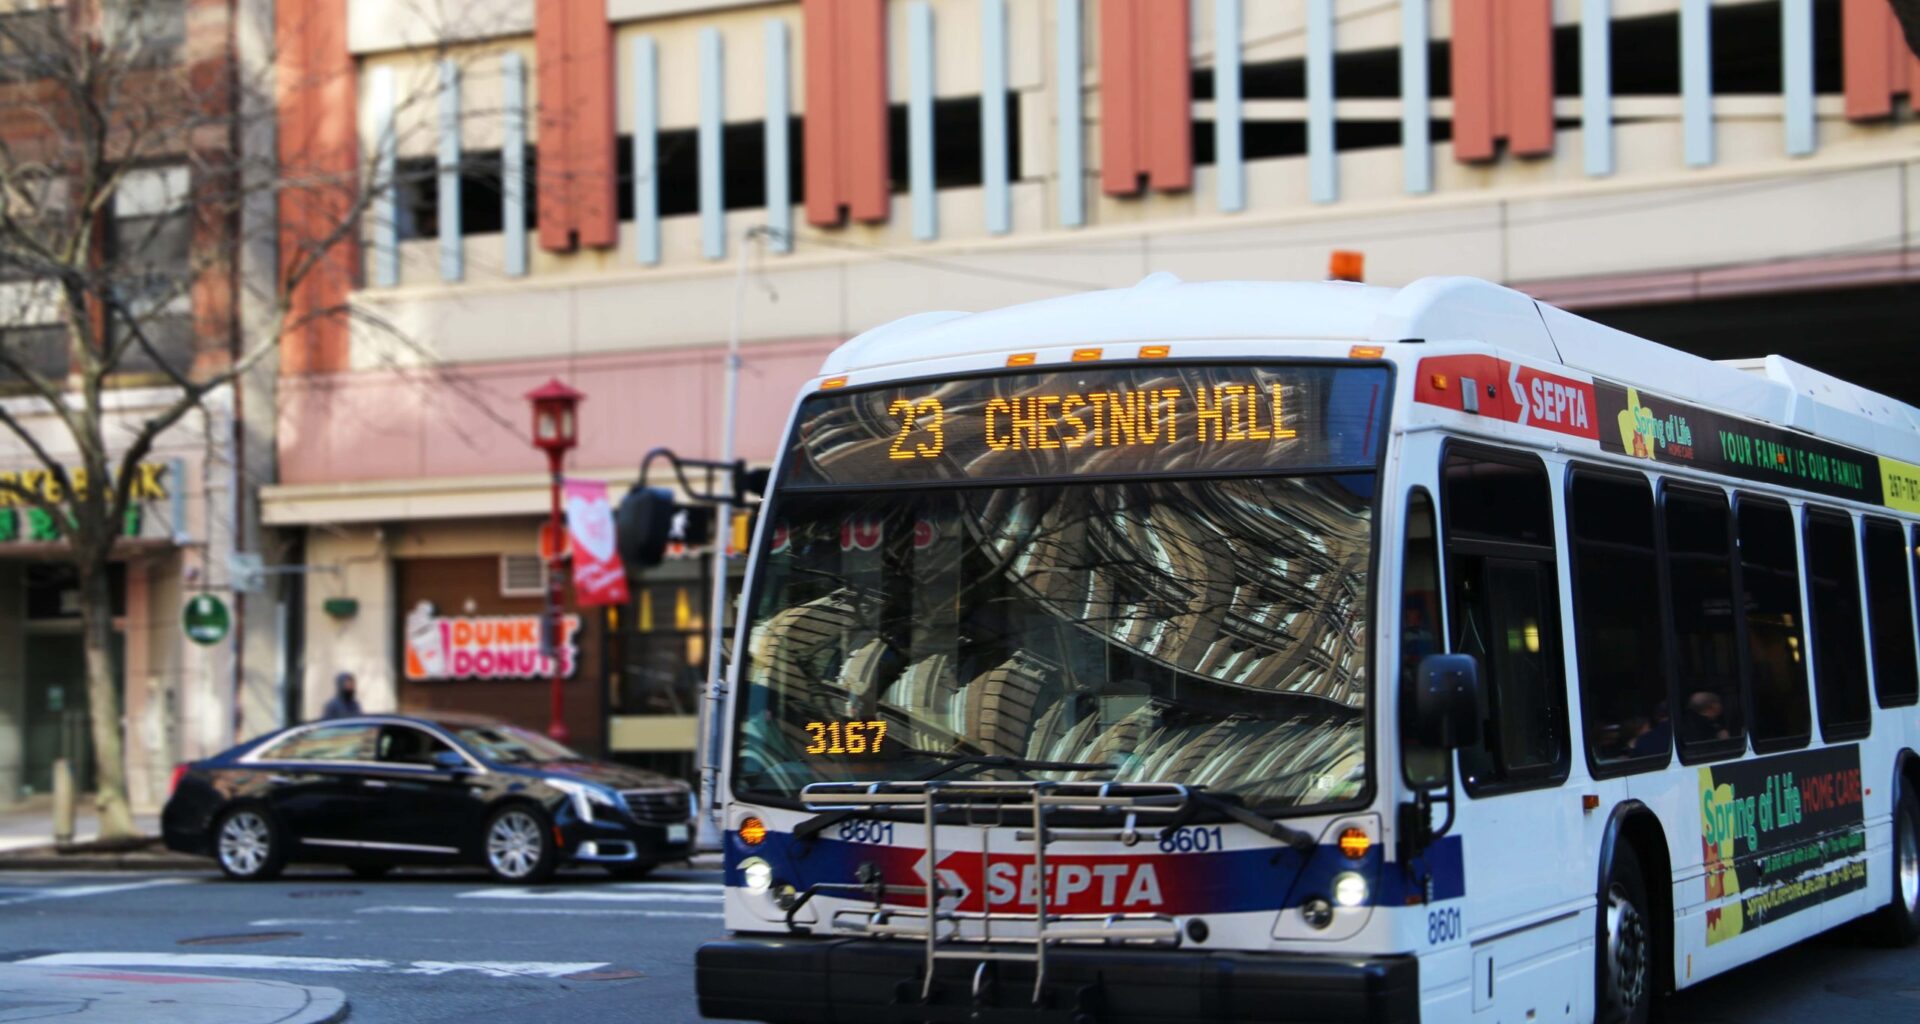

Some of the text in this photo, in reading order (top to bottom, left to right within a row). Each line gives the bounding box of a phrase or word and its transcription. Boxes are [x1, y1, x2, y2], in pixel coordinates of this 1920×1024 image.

[888, 383, 1297, 460] 23 CHESTNUT HILL
[1531, 377, 1589, 429] SEPTA
[1634, 406, 1692, 449] Spring of Life
[1718, 430, 1753, 466] YOUR
[1795, 449, 1807, 479] IS
[1808, 452, 1833, 482] OUR
[1832, 457, 1864, 490] FAMILY
[805, 720, 887, 754] 3167
[839, 820, 893, 844] 8601
[1703, 783, 1759, 858] Spring
[1758, 776, 1773, 832] of
[1774, 771, 1802, 828] Life
[1801, 773, 1834, 814] HOME
[1834, 768, 1862, 805] CARE
[1159, 826, 1223, 853] 8601
[987, 862, 1164, 906] SEPTA
[1428, 907, 1462, 946] 8601
